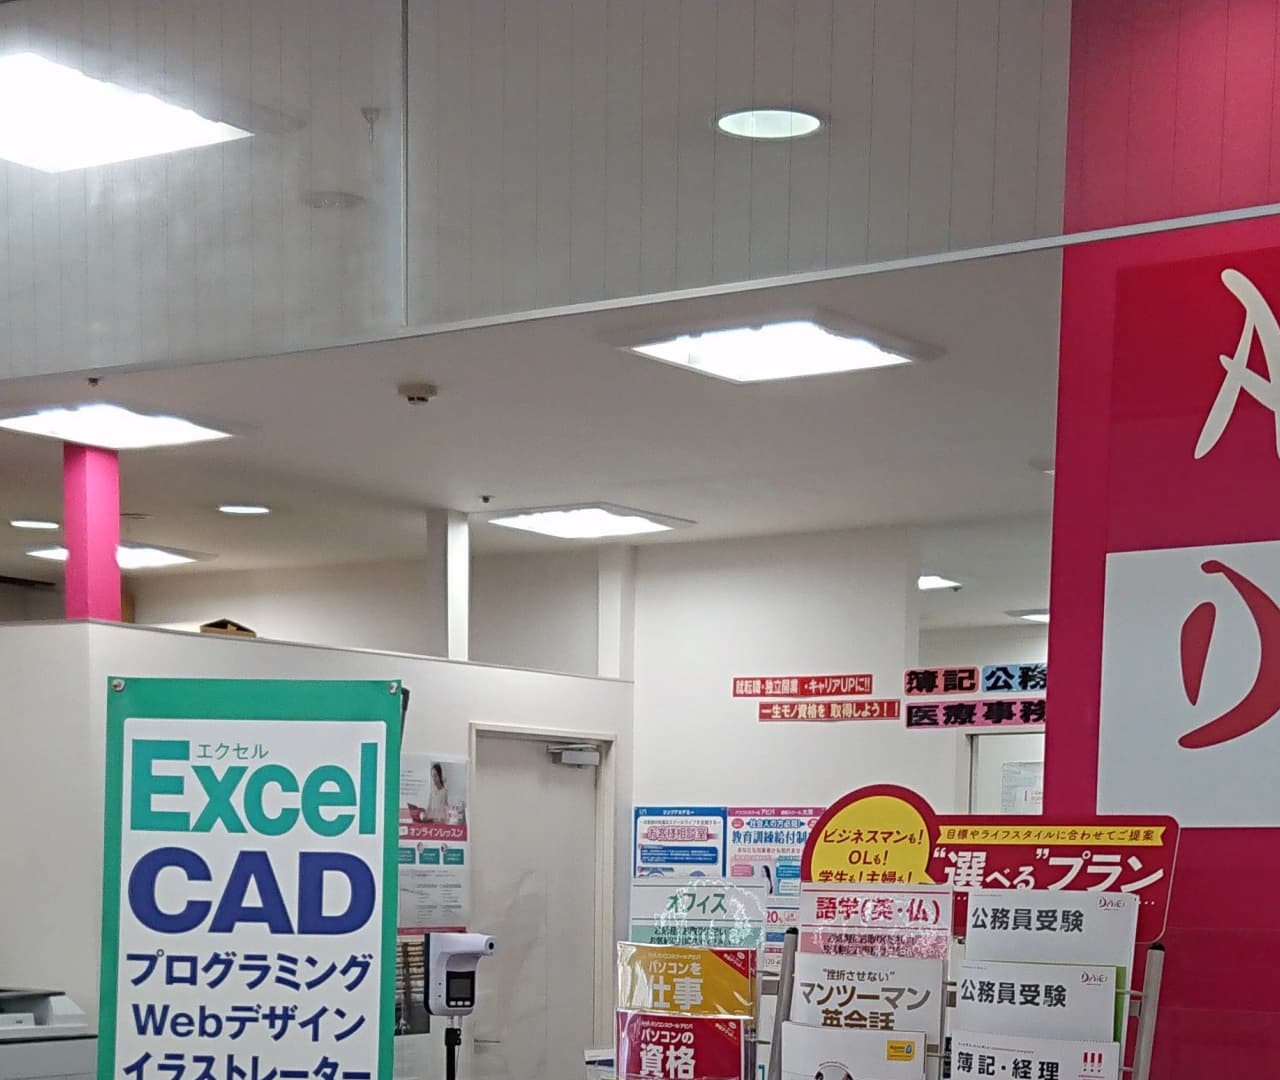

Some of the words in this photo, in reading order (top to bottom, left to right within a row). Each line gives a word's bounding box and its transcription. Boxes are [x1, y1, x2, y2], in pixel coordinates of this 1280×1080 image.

[906, 669, 976, 692] 簿記
[761, 704, 825, 719] 一生モノ資格を
[196, 743, 268, 760] エクセル
[131, 739, 378, 836] Excel
[409, 827, 463, 838] オンラインレッスン
[823, 829, 923, 845] ビジネスマンも!
[946, 829, 1156, 842] 目標やライフスタイルに合わせてご提案
[849, 850, 888, 866] OLも!
[128, 846, 376, 935] CAD
[667, 893, 727, 914] オフィス
[972, 907, 1084, 932] 公務員受験
[126, 949, 373, 992] プログラミング
[649, 961, 702, 975] パソコンを
[648, 976, 703, 1010] 仕事
[800, 982, 931, 1010] マンツーマン
[961, 979, 1067, 1007] 公務員受験
[132, 1003, 366, 1042] Webデザイン
[821, 1008, 895, 1030] 英会話
[642, 1029, 694, 1044] パソコンの
[640, 1044, 696, 1079] 資格
